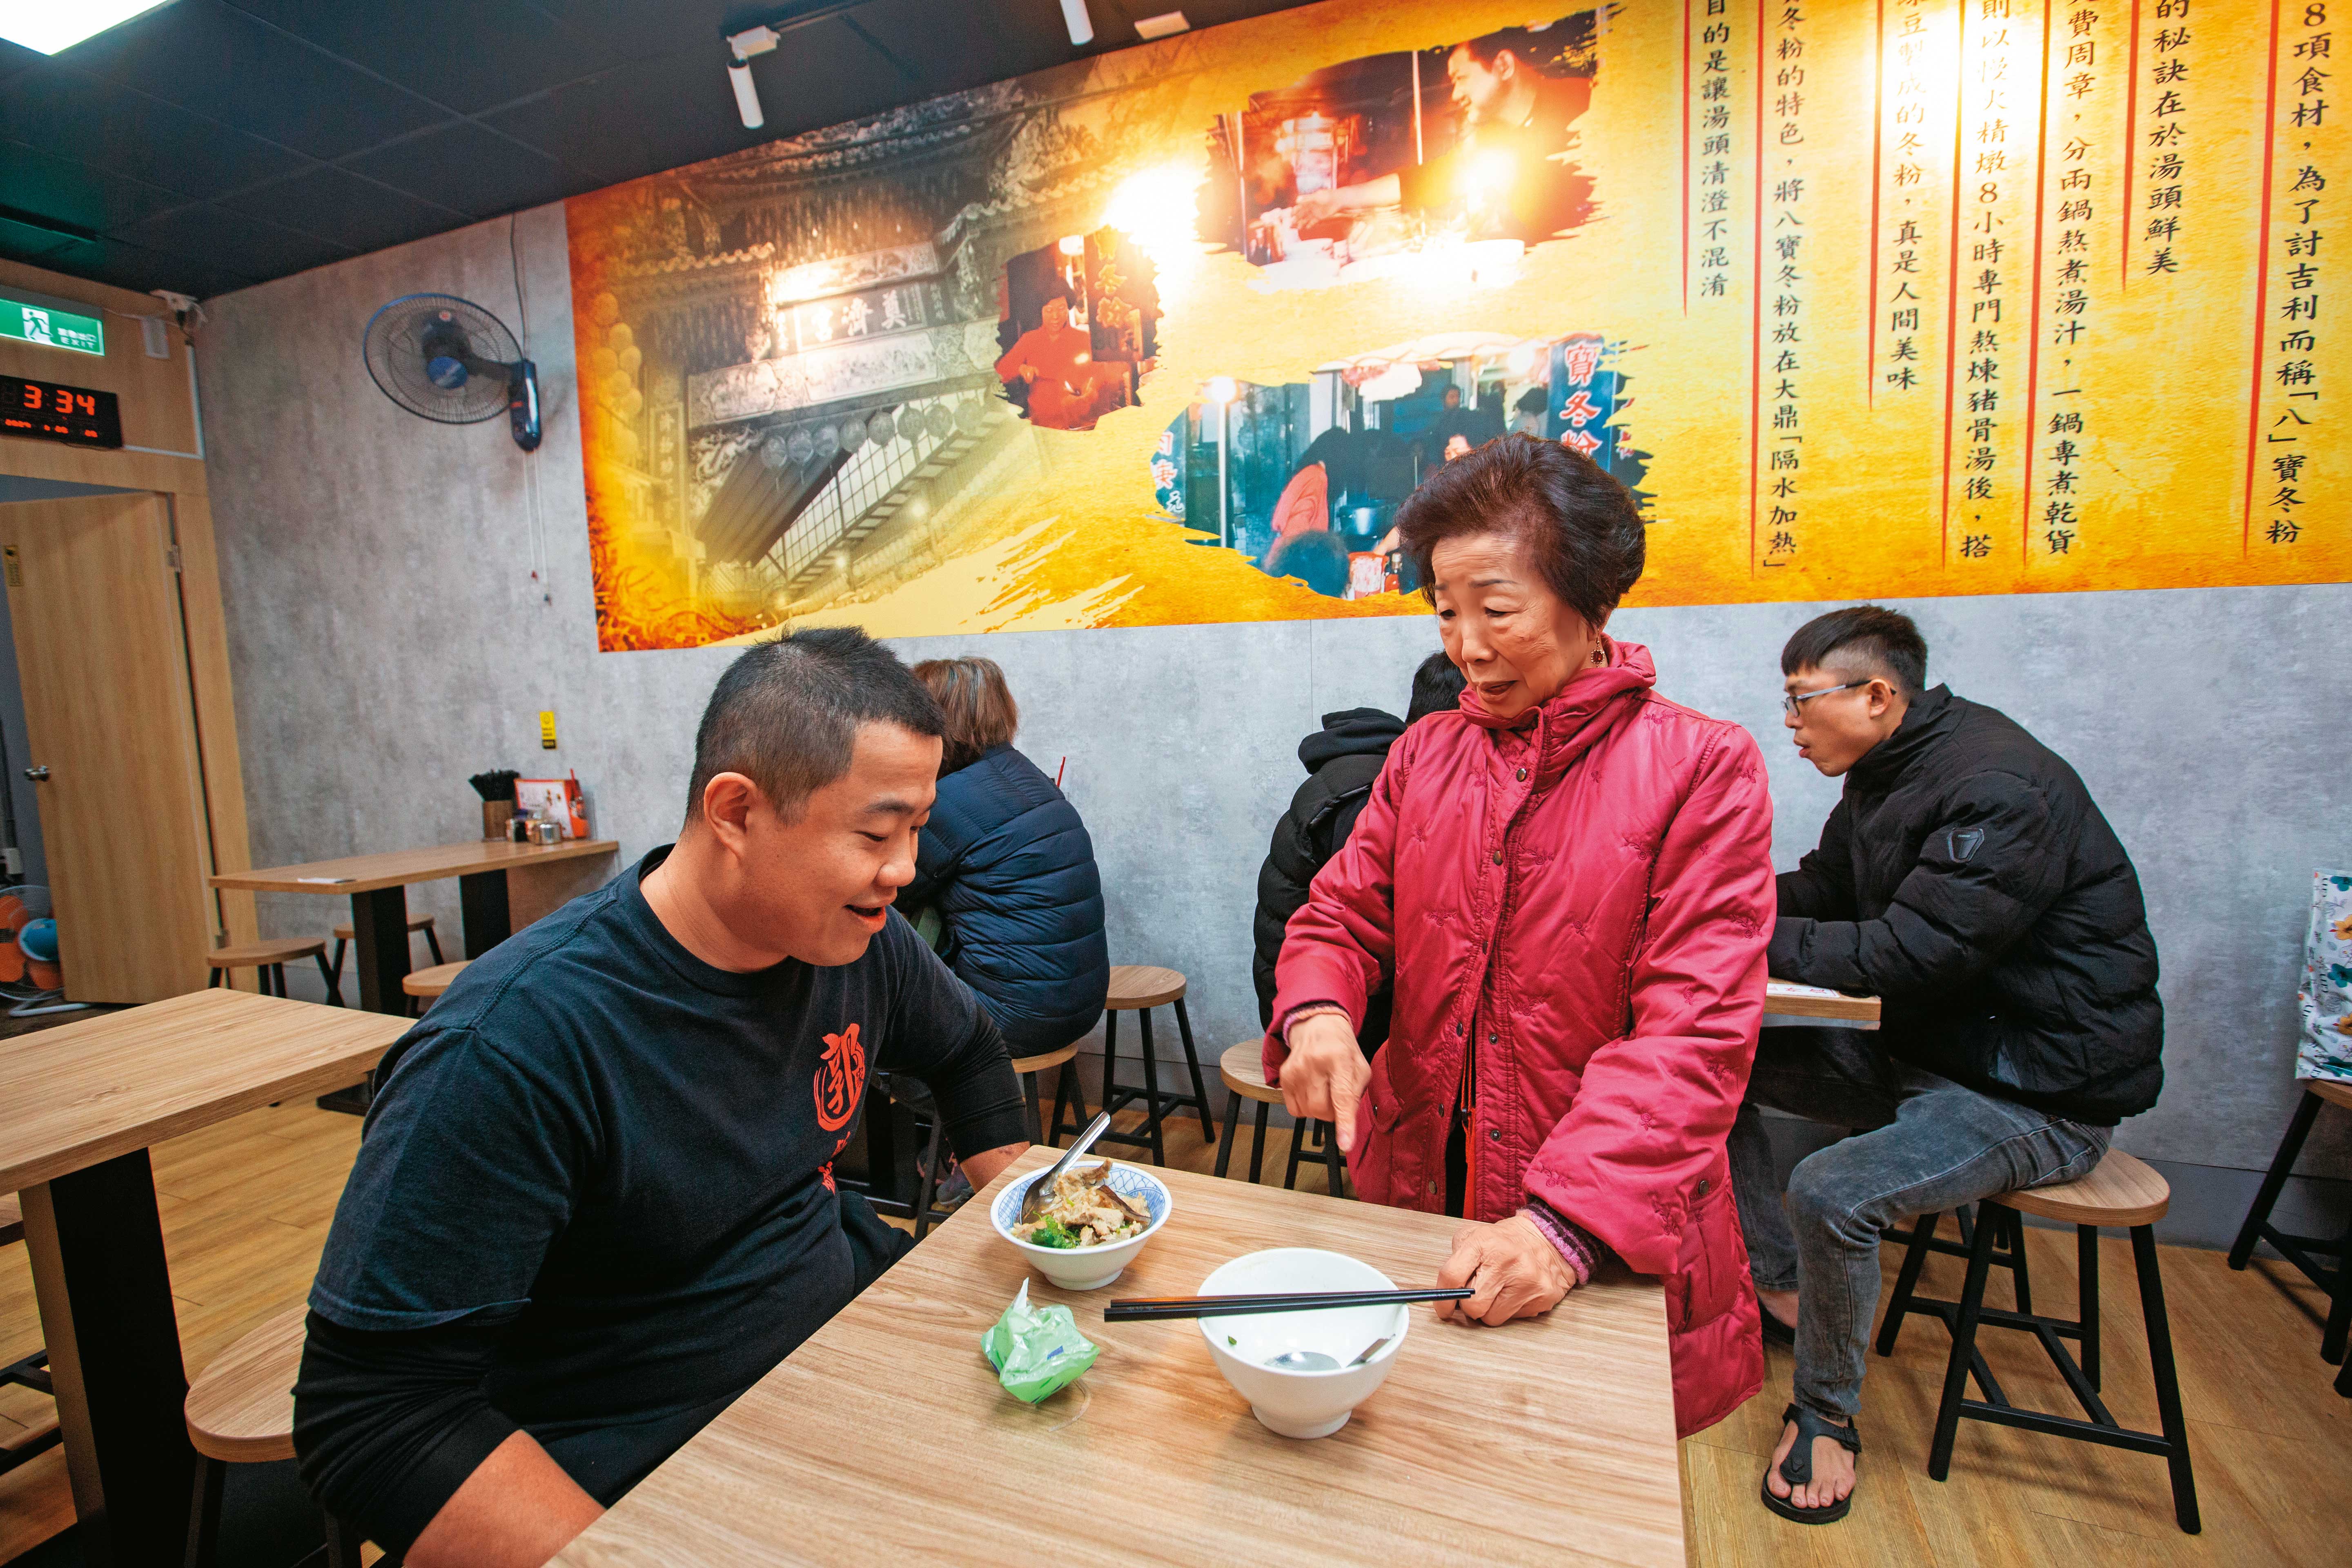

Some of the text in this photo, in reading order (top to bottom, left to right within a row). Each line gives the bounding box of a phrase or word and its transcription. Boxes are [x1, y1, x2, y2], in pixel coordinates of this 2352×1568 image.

[1764, 0, 1808, 567] 冬粉的特色，將八寶冬粉放在大鼎「隔水加熱」
[1887, 0, 1928, 390] 豆製成的冬粉，真是人間美味
[2043, 0, 2099, 555] 費周章，分兩鍋熬煮湯汁，一鍋專煮乾貨
[2144, 0, 2192, 276] 的秘訣在於湯頭鮮美
[60, 336, 95, 349] EXIT
